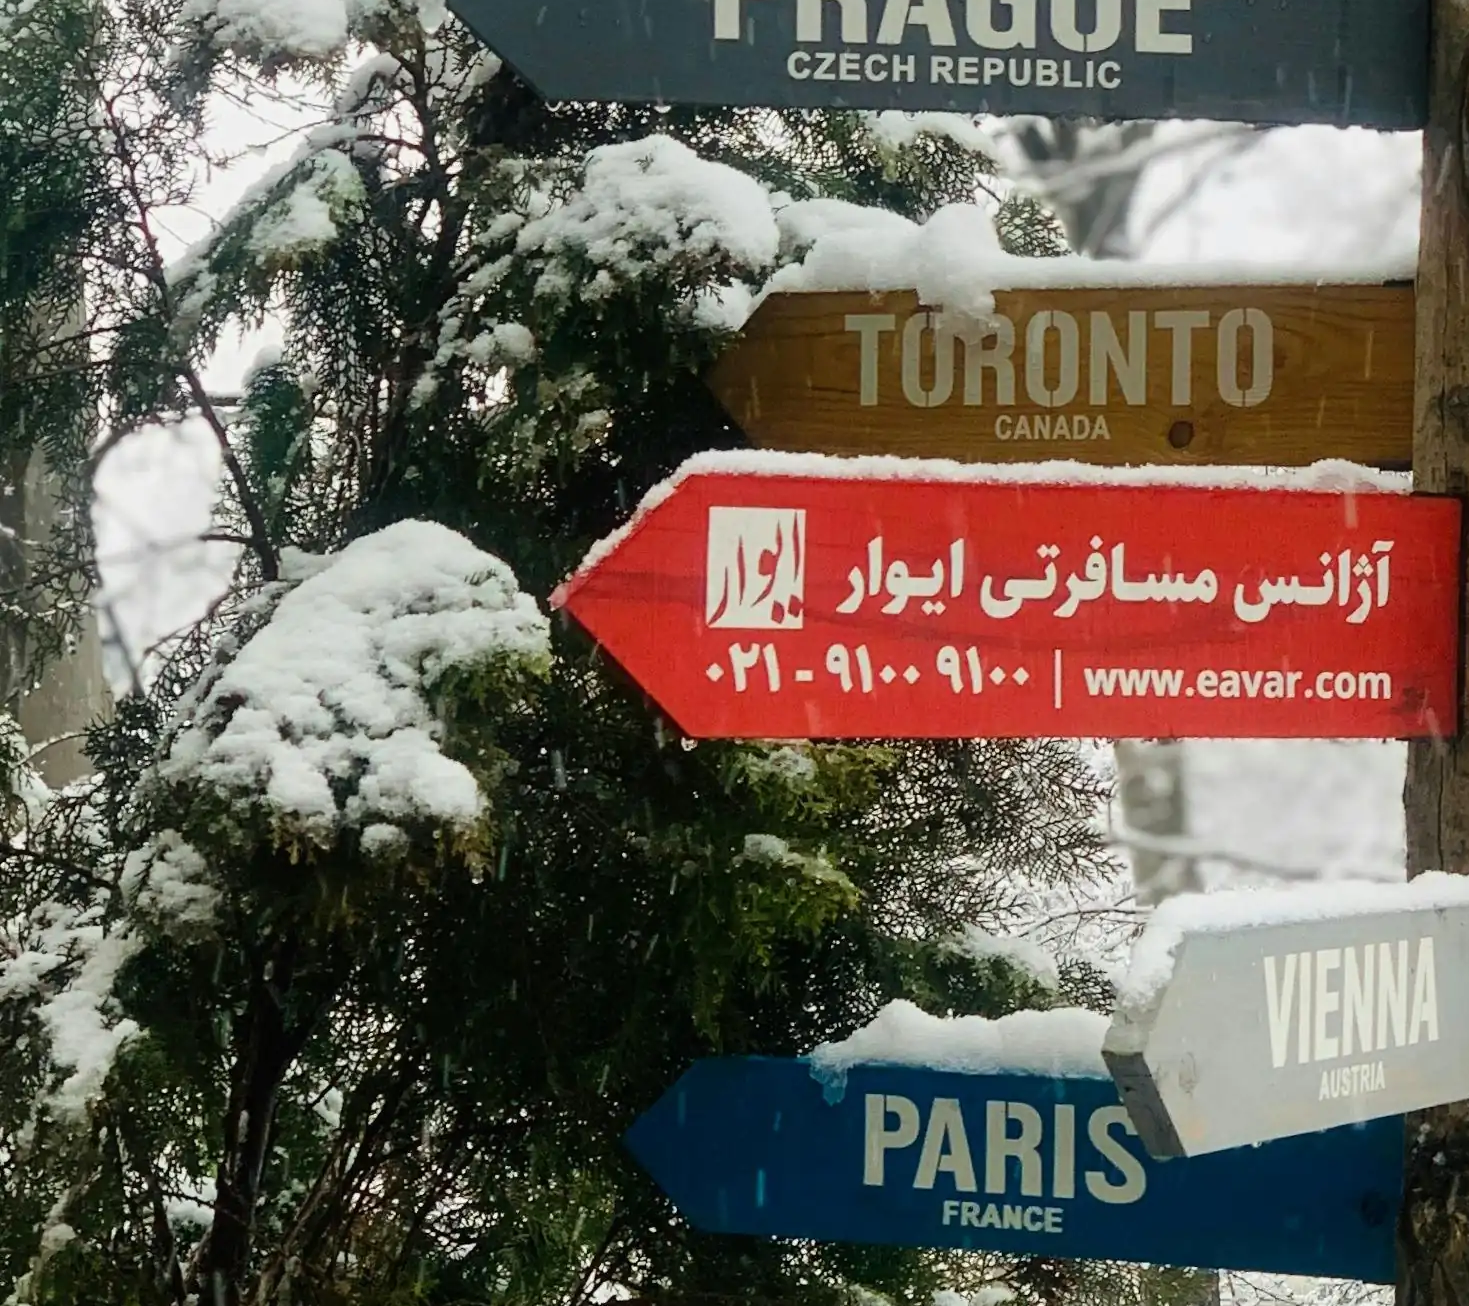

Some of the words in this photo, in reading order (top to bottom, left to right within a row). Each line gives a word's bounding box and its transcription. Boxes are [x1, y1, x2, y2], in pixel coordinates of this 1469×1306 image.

[786, 50, 917, 84] CZECH
[929, 55, 1123, 91] REPUBLIC
[844, 307, 1274, 408] TORONTO
[994, 413, 1111, 441] CANADA
[836, 536, 965, 616] ایوار
[980, 534, 1218, 619] مسافرتی
[1233, 540, 1395, 624] آژانس
[1083, 667, 1392, 700] www.eavar.com
[1263, 936, 1440, 1068] VIENNA
[1318, 1060, 1386, 1102] AUSTRIA
[863, 1093, 1146, 1205] PARIS
[941, 1199, 1064, 1234] FRANCE
